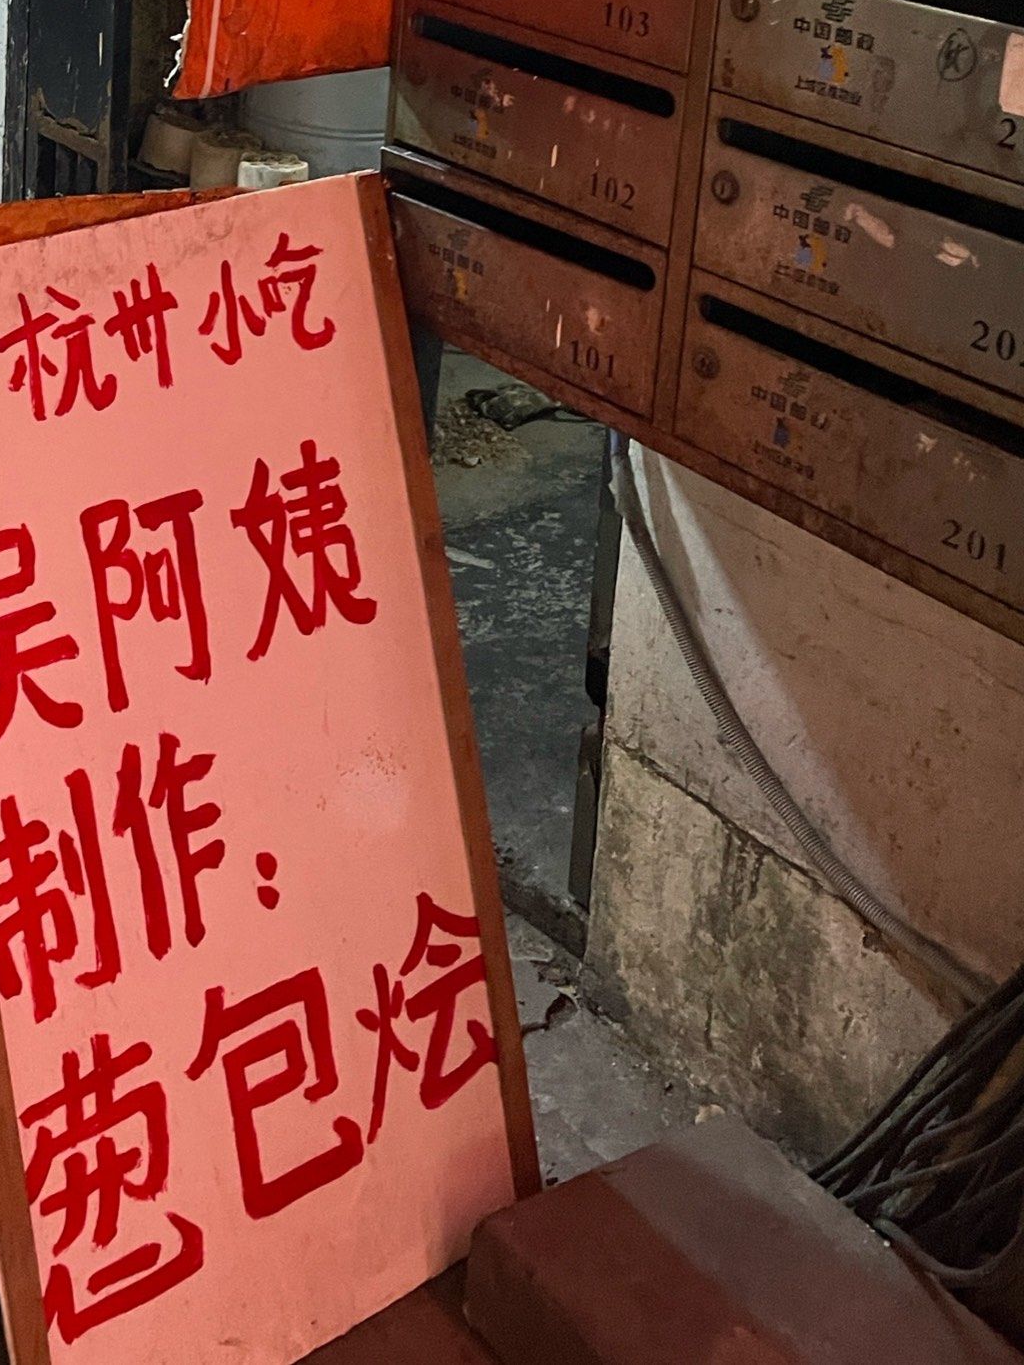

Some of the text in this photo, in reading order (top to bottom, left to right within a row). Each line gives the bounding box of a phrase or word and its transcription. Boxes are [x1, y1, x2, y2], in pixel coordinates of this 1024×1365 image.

[603, 1, 650, 37] 103
[793, 17, 875, 54] 中国邮政
[589, 170, 636, 211] 102
[568, 339, 617, 379] 101
[970, 320, 1024, 368] 20
[942, 519, 1006, 574] 201
